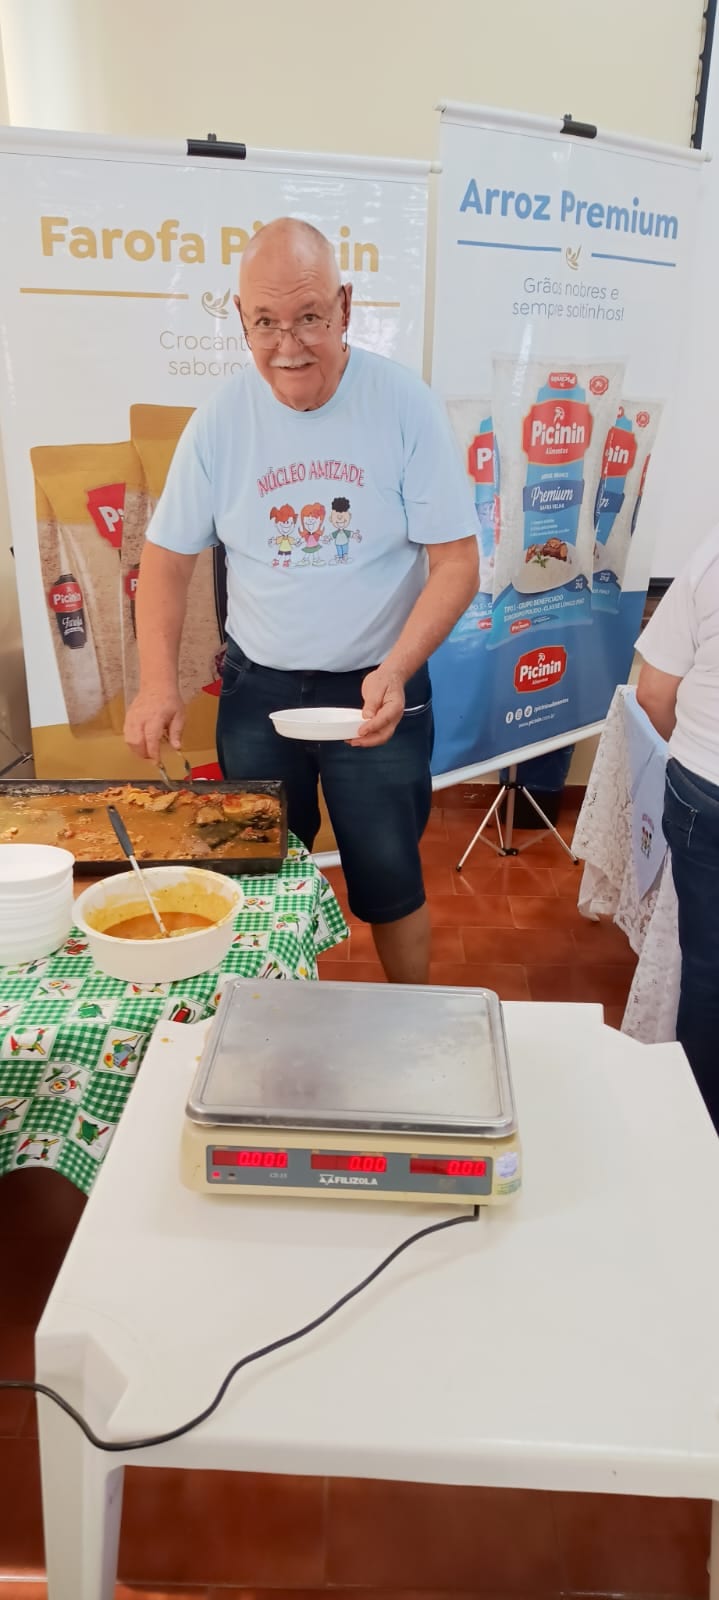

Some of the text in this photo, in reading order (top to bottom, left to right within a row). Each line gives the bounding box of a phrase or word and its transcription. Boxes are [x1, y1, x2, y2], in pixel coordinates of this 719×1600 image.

[459, 178, 679, 240] Arroz Premium
[40, 215, 205, 264] Farofa
[523, 277, 620, 300] Grãos nobres e
[511, 302, 564, 320] sempre
[159, 330, 247, 351] Crocant
[531, 420, 585, 447] Picinin
[256, 459, 365, 498] NÚCLEO AMIZADE
[530, 486, 574, 507] Premium
[519, 660, 562, 682] Picinin
[334, 1176, 379, 1186] FILIZOLA
